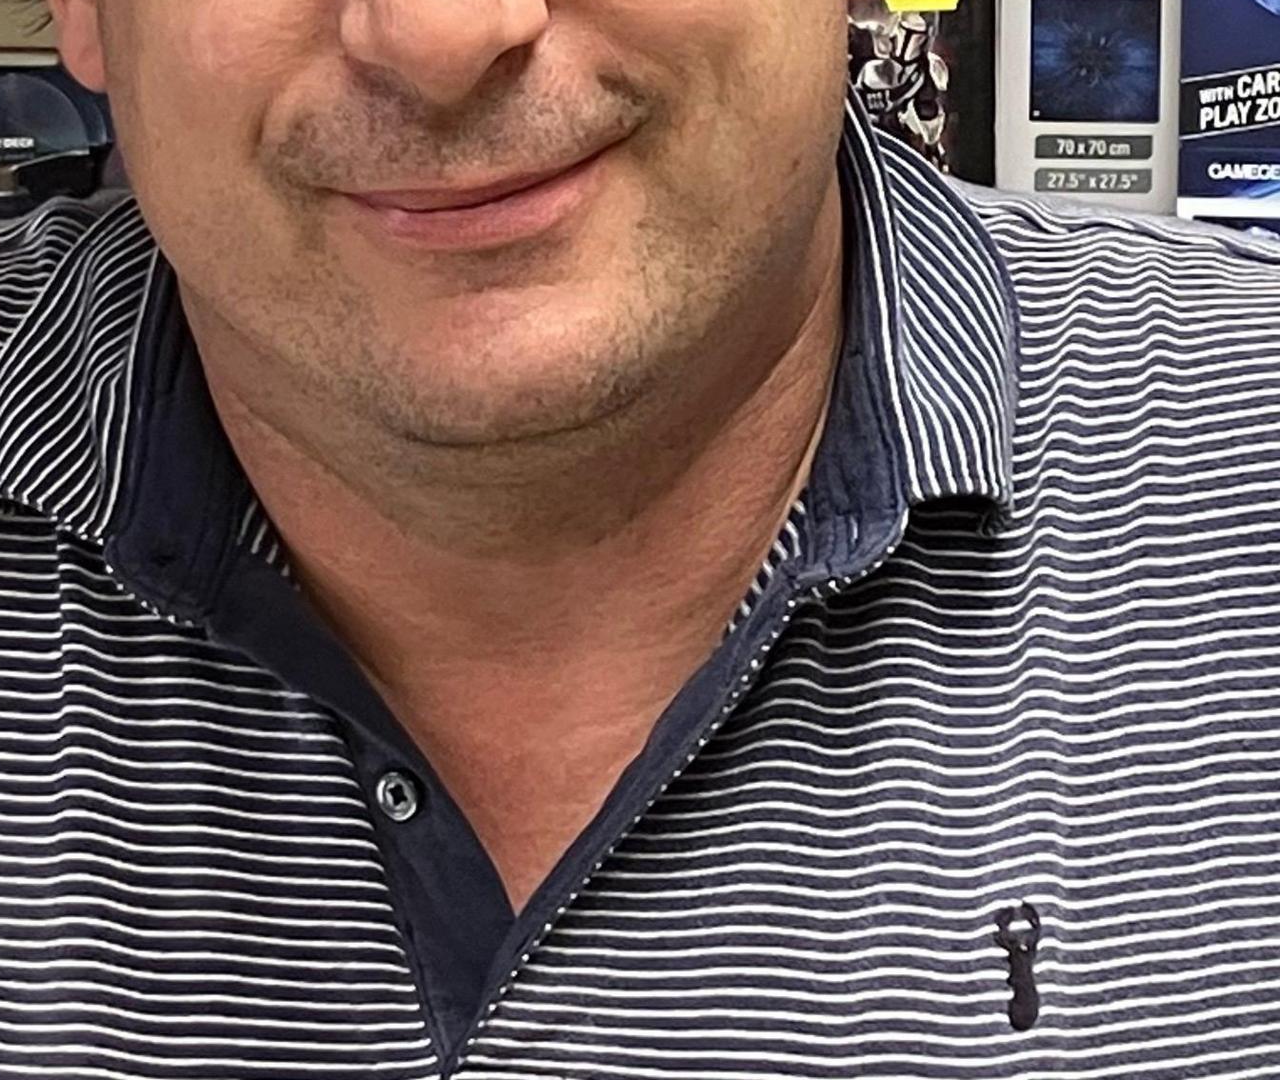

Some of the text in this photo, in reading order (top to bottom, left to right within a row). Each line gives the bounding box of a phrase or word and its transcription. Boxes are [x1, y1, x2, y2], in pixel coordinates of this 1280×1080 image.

[1199, 85, 1234, 105] WITH
[1200, 103, 1251, 130] PLAY
[3, 137, 34, 149] DECK
[1057, 140, 1130, 155] 70 x 70 cm
[1048, 174, 1138, 189] 27.5" x 27.5"
